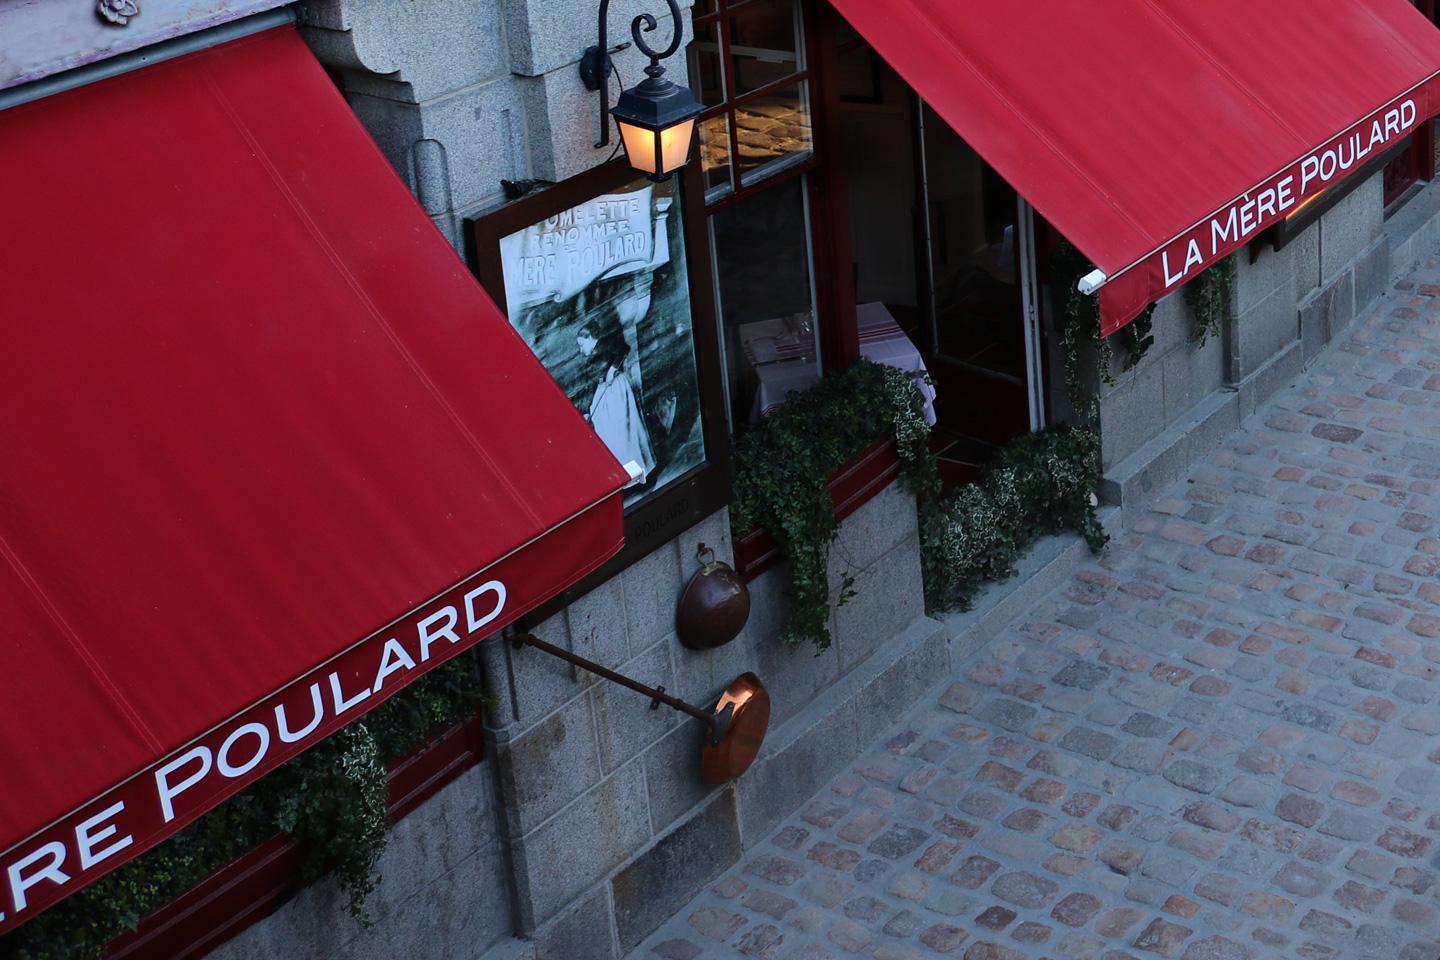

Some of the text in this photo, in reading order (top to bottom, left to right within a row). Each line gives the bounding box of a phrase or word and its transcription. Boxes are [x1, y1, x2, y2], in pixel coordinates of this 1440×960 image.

[566, 230, 646, 281] POULARD
[1161, 99, 1417, 289] LA MÈRE POULARD
[0, 580, 508, 923] RE POULARD
